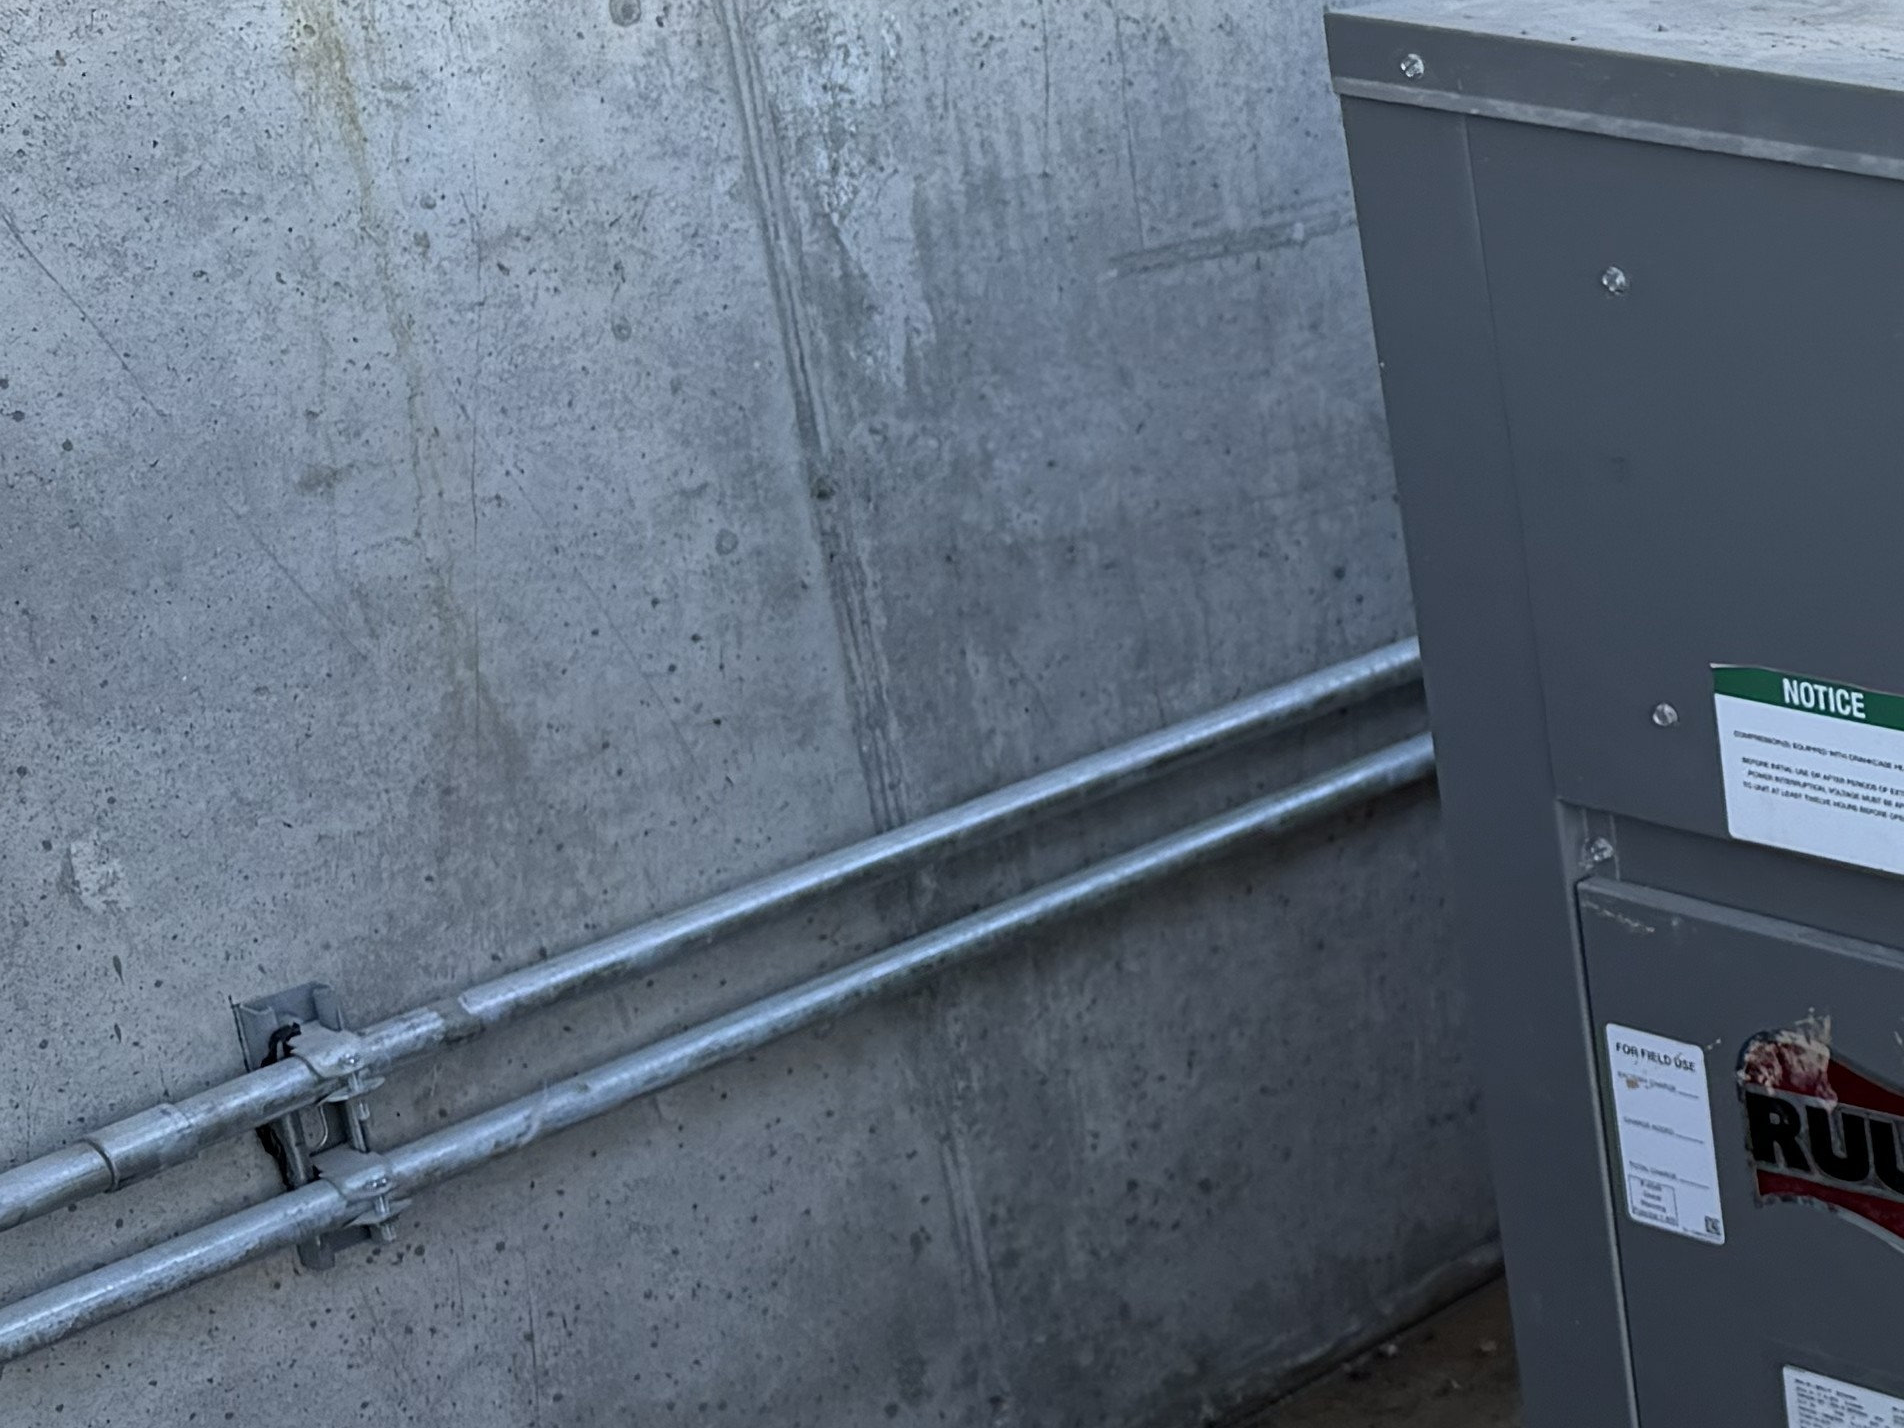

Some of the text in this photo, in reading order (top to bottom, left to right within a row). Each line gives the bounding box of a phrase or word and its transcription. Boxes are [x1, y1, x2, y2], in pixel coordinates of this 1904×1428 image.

[1781, 677, 1867, 720] NOTICE
[1616, 1041, 1697, 1072] FOR FIELD USE
